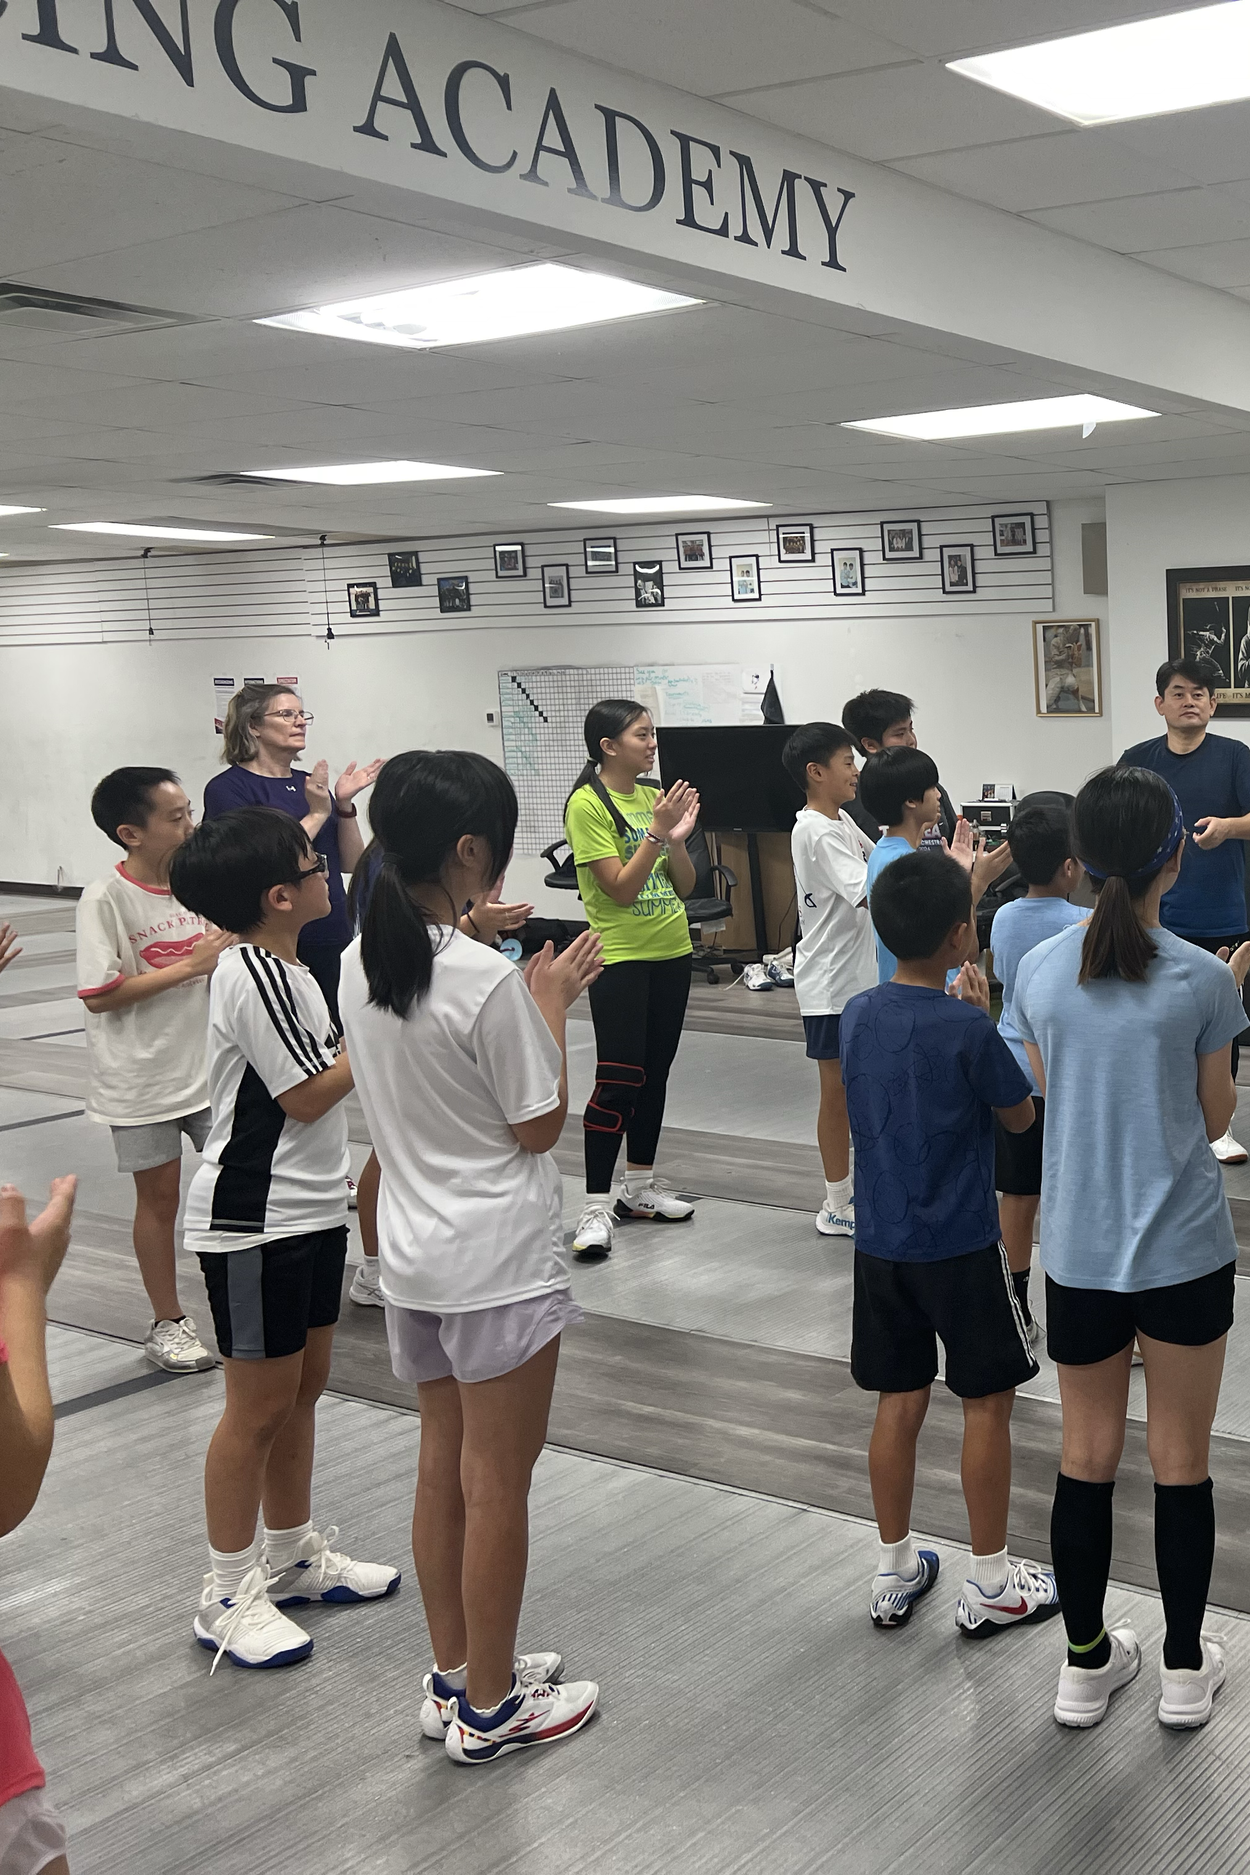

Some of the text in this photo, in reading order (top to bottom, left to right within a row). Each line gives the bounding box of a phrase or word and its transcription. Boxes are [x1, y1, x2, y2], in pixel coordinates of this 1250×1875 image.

[352, 31, 856, 273] ACADEMY
[128, 920, 175, 944] SNACK
[637, 1202, 655, 1210] FILA
